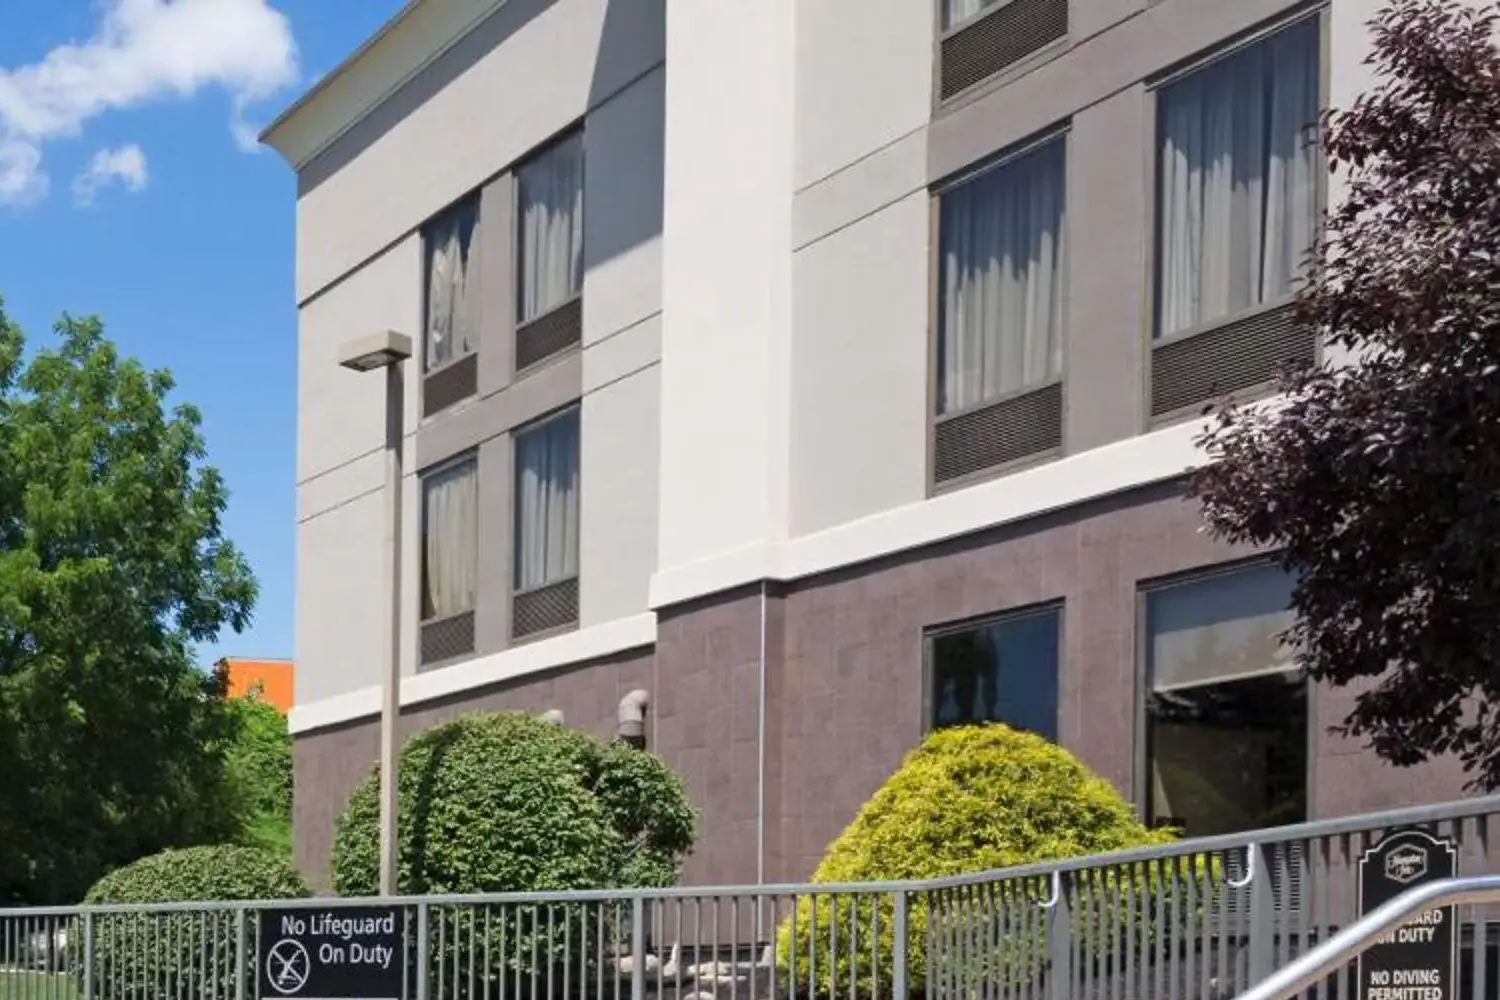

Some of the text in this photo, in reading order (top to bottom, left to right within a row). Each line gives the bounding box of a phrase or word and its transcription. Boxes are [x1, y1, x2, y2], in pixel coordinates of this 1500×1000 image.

[281, 911, 395, 940] No Lifeguard
[1399, 926, 1435, 943] DUTY
[319, 943, 393, 969] On Duty
[1370, 968, 1441, 985] NO DIVING
